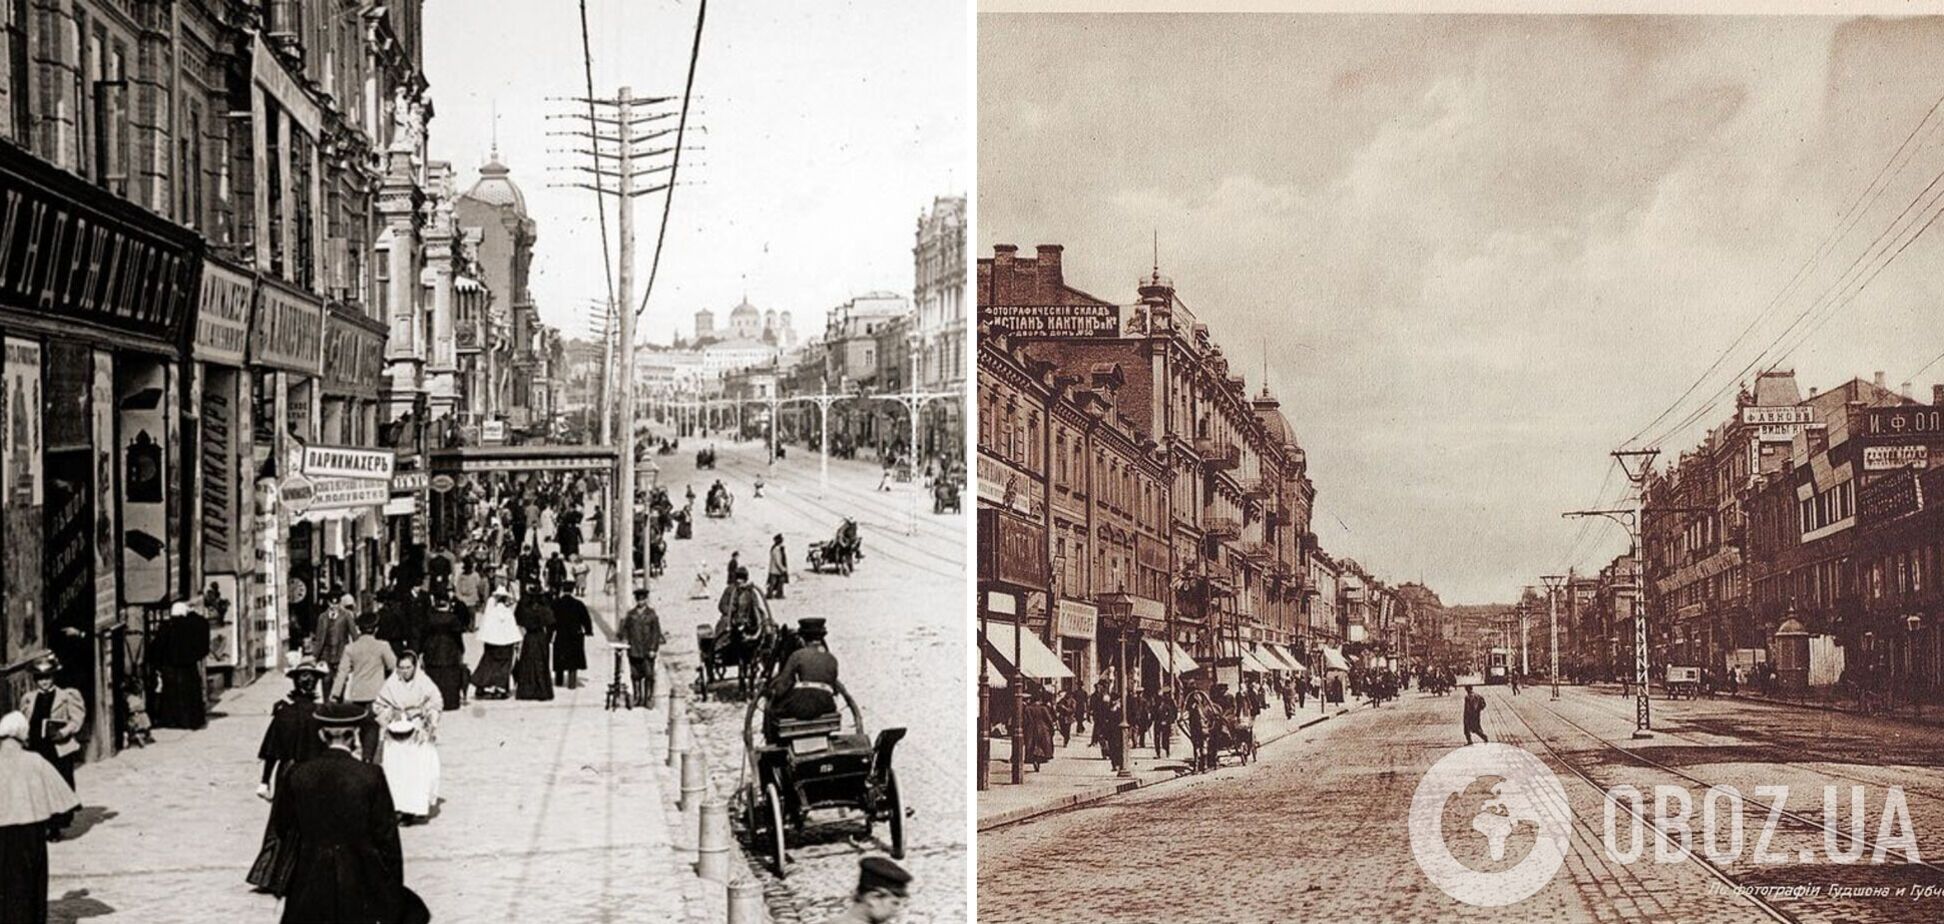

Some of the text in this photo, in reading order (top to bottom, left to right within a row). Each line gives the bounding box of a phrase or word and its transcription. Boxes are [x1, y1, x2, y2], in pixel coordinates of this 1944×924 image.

[1074, 306, 1110, 317] СКЛАДЪ
[984, 316, 1044, 330] ИСТІАНЪ
[309, 451, 389, 472] ПАРИКМАХЕРЪ
